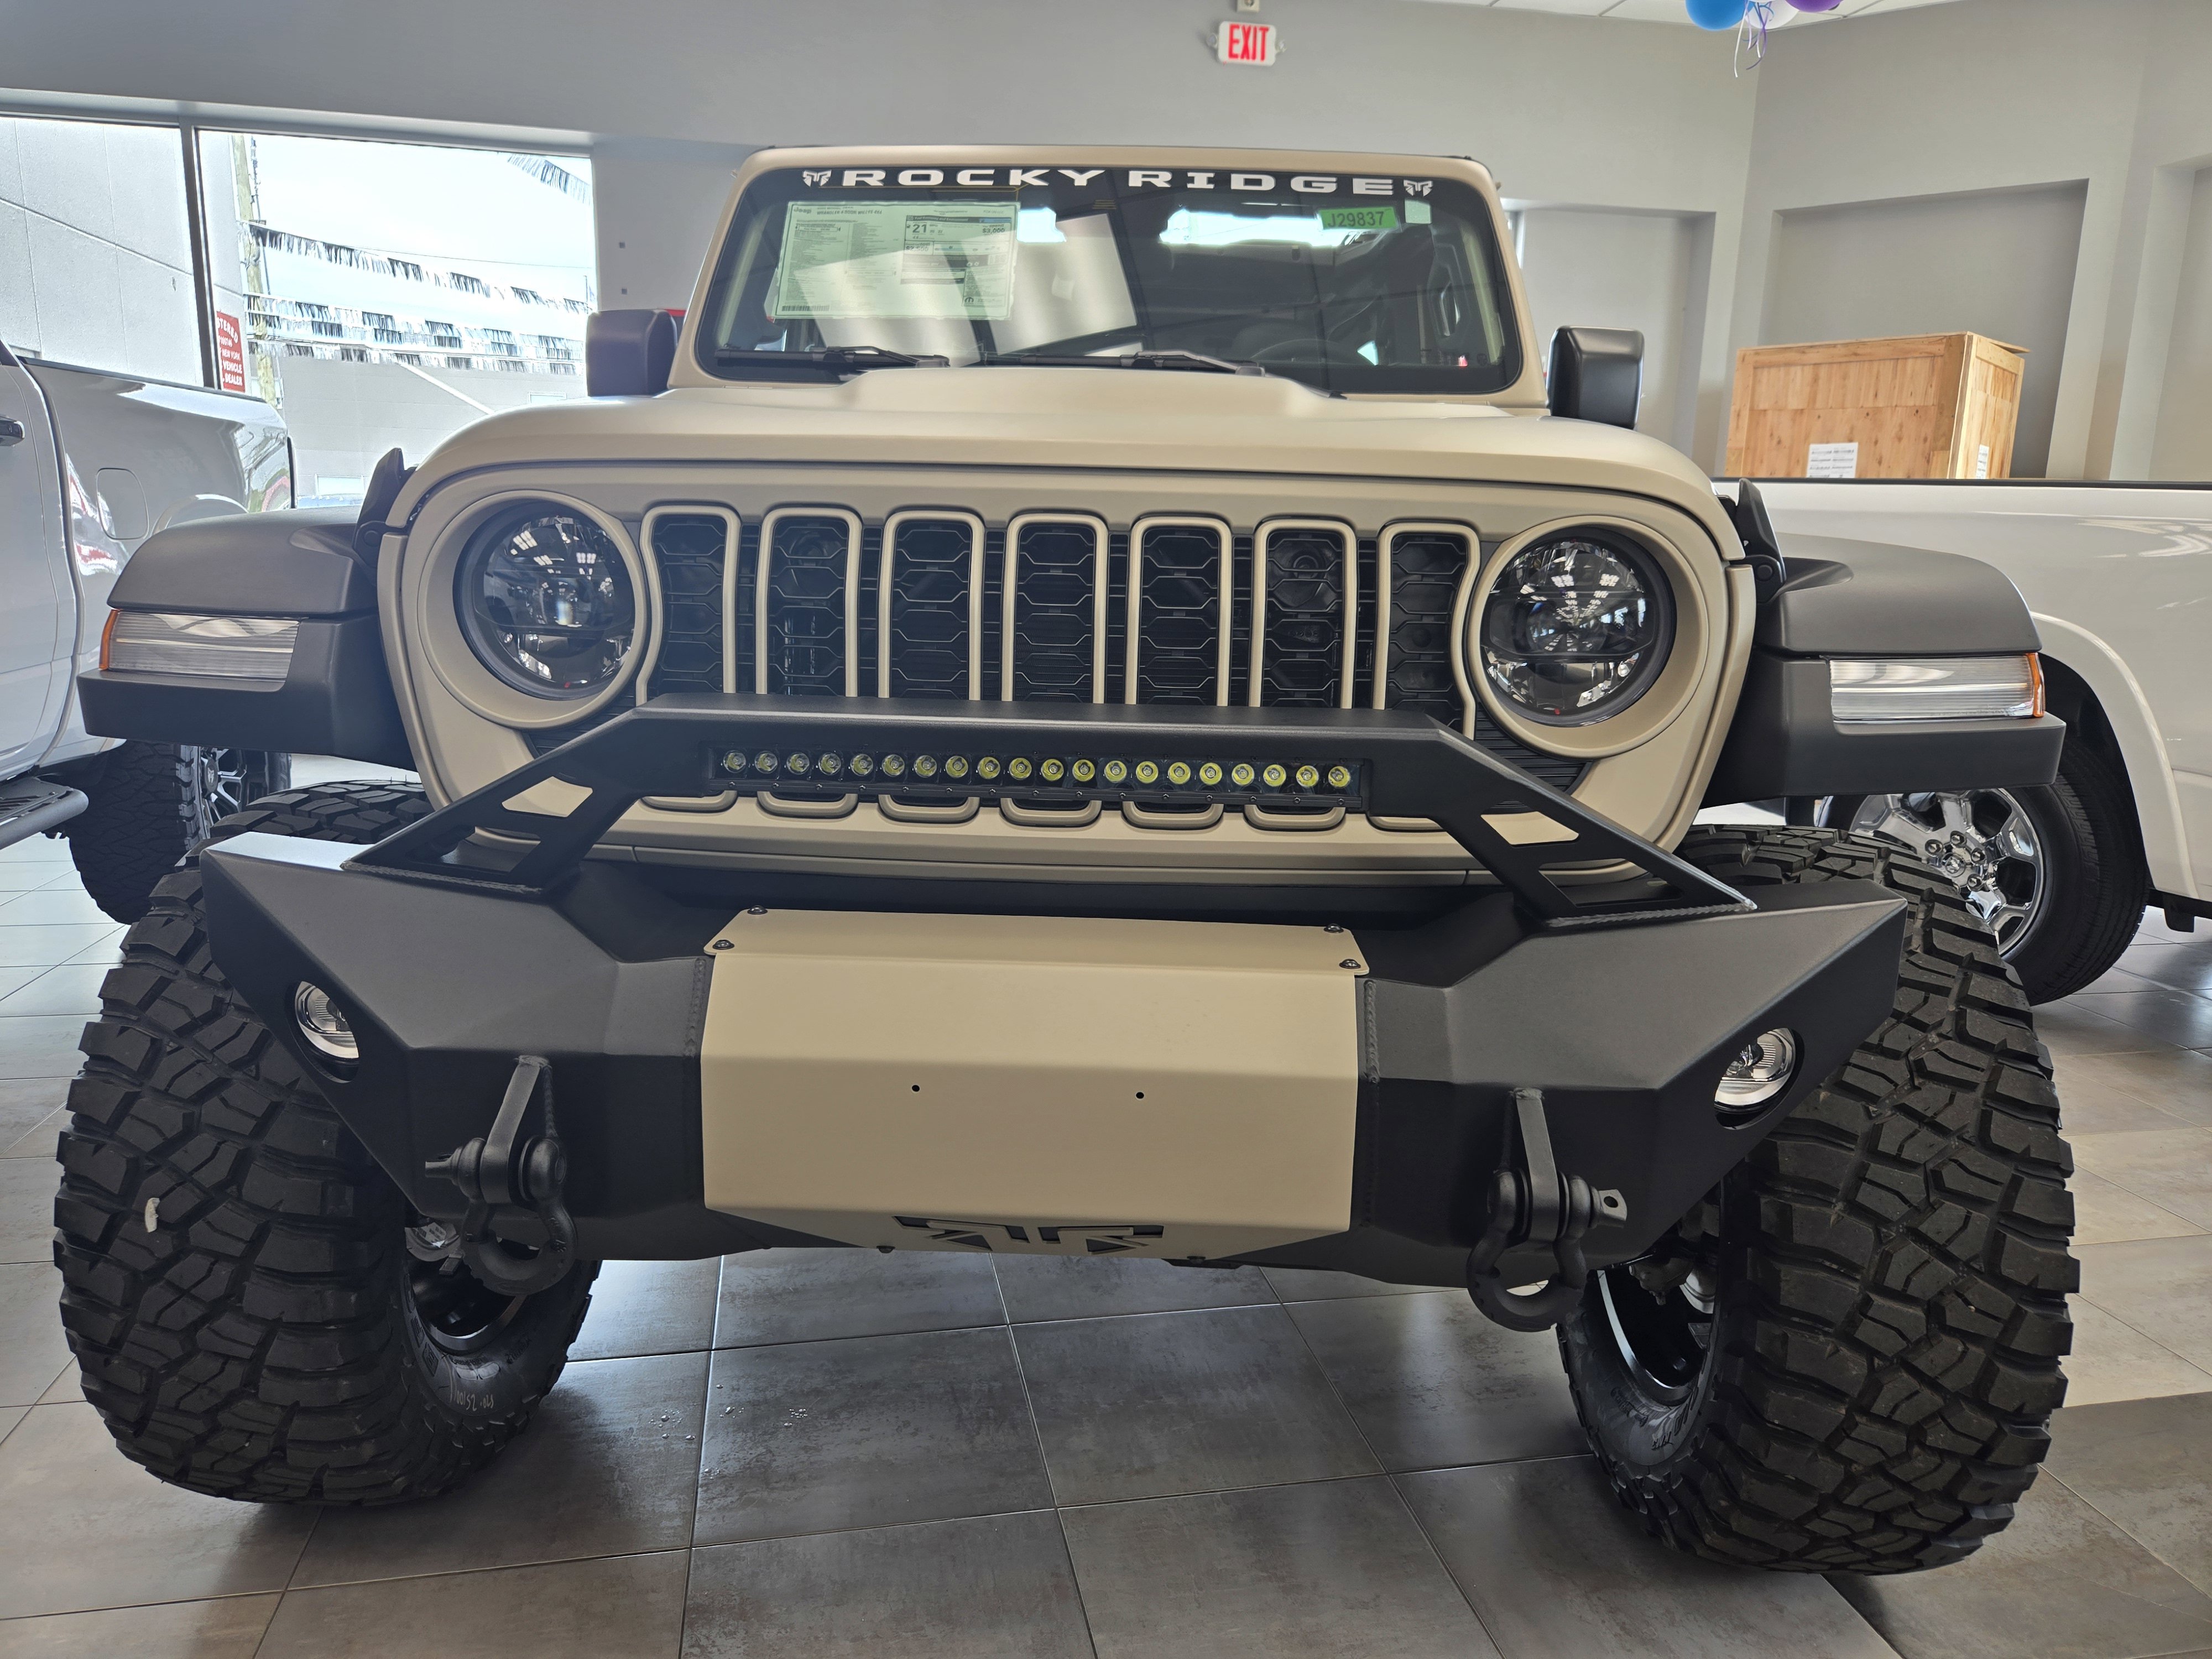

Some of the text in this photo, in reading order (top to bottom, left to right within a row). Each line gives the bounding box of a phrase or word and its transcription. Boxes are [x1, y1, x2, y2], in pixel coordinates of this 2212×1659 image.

[1228, 24, 1269, 62] EXIT
[842, 169, 1395, 195] ROCKY RIDGE
[1328, 212, 1384, 227] J29837
[912, 223, 927, 233] 21
[222, 359, 242, 374] VEHICLE
[225, 372, 242, 386] DEALER
